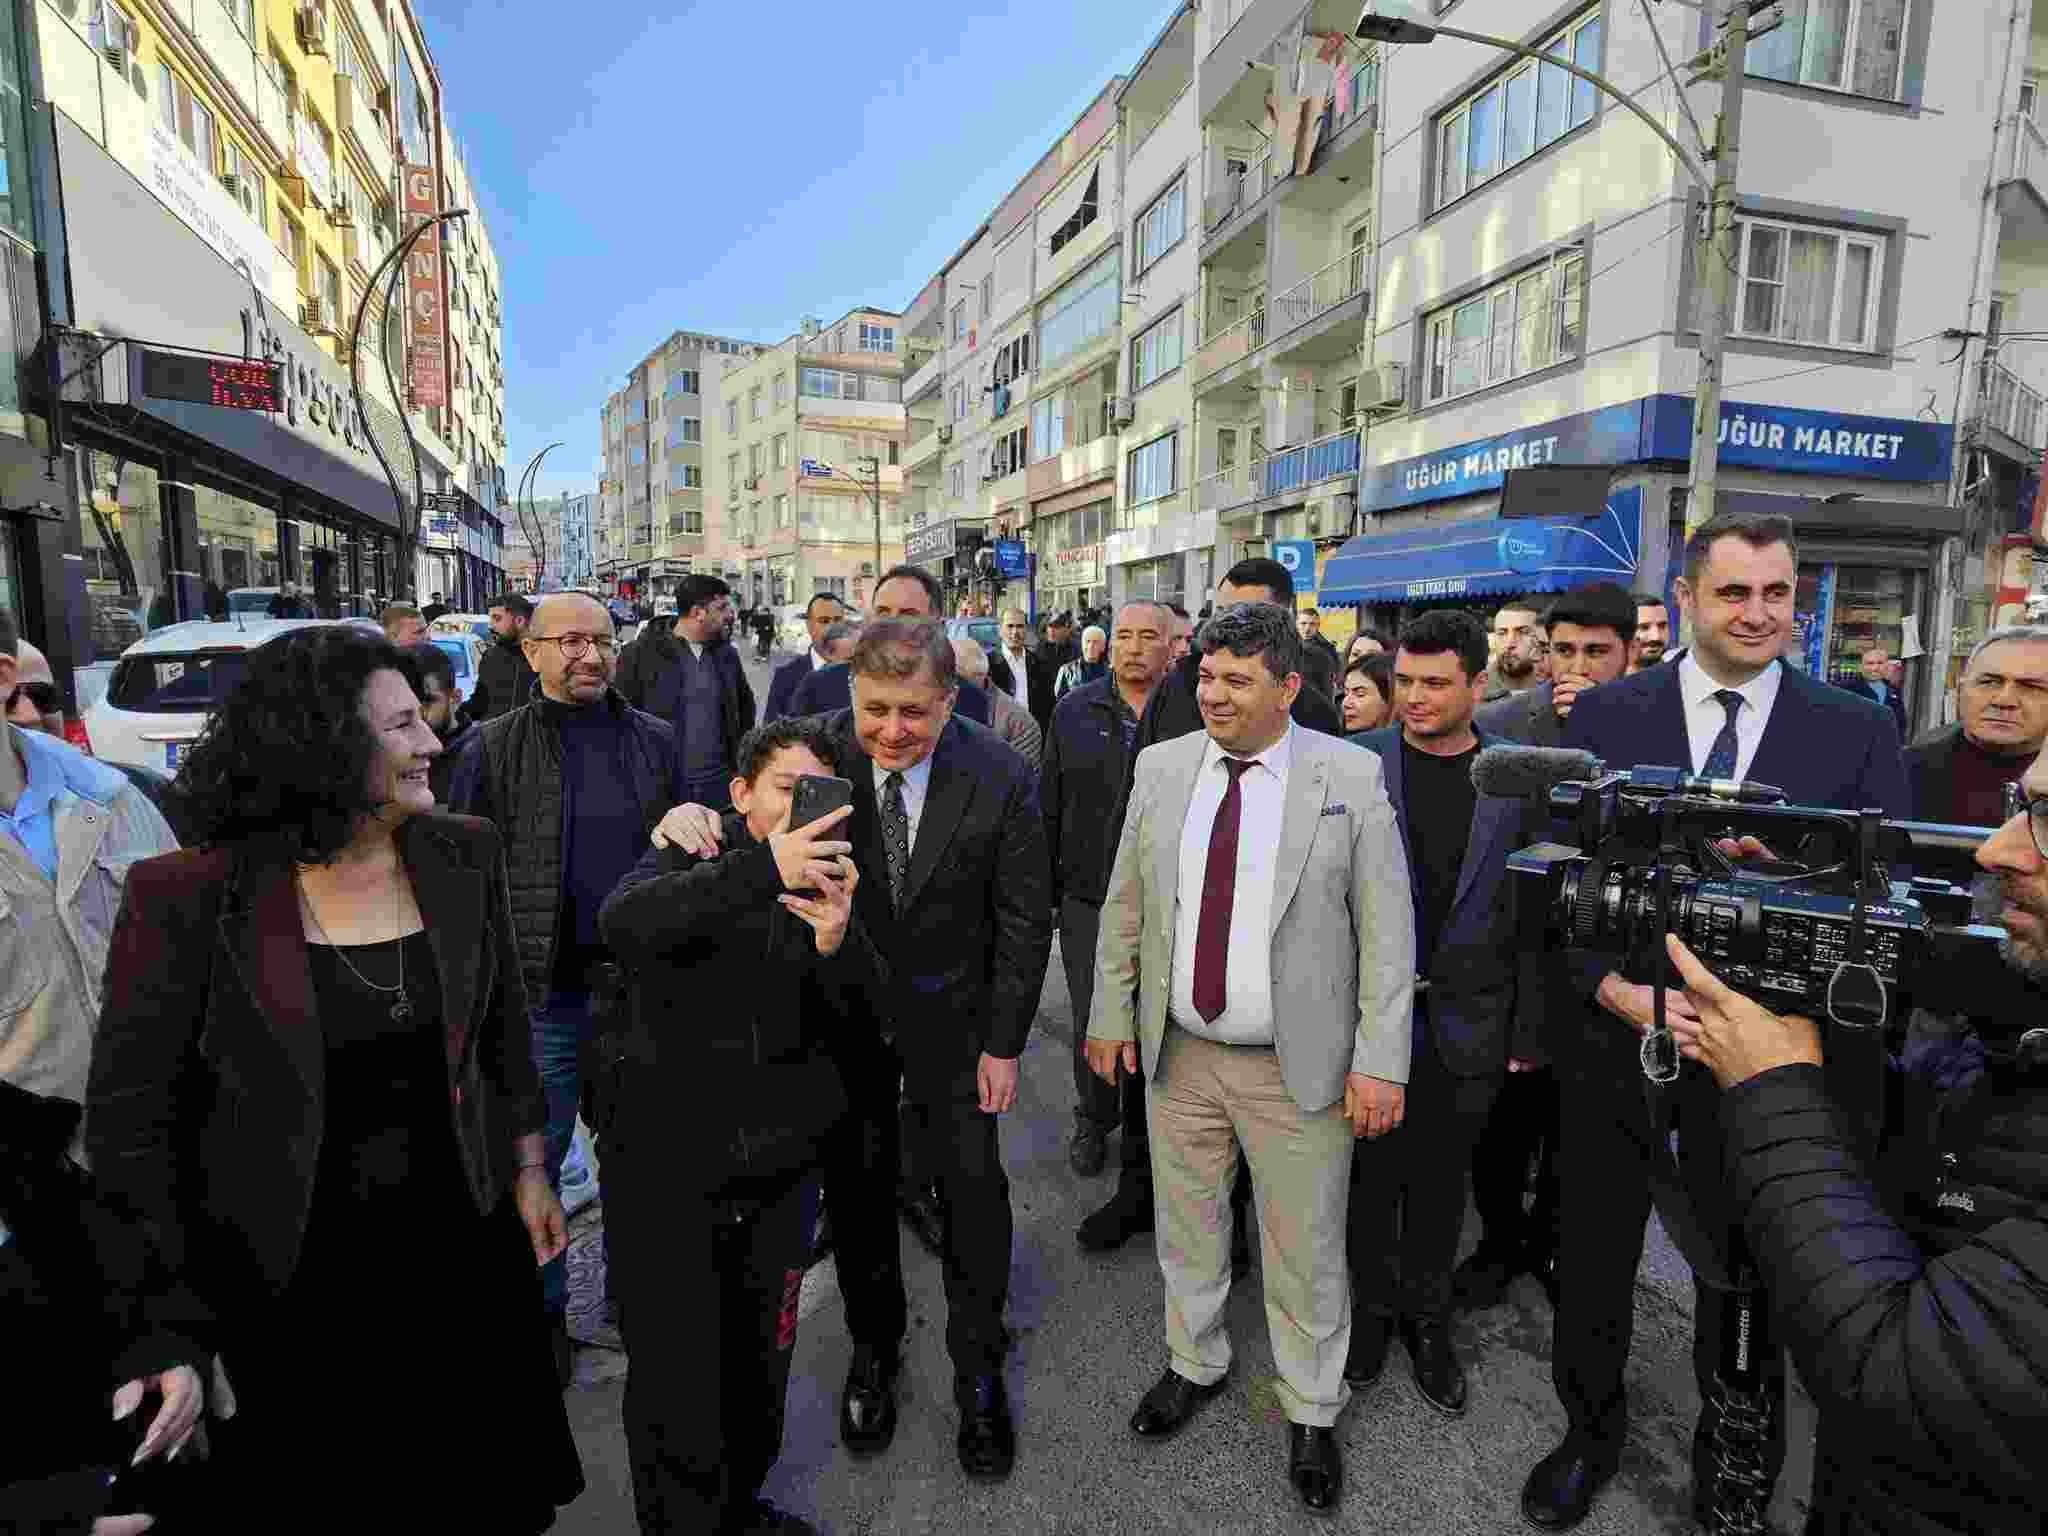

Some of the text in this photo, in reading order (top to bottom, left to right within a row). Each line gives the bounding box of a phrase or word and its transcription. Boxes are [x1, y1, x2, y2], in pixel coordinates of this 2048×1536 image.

[1717, 415, 1904, 460] UĞUR MARKET
[1406, 436, 1559, 490] UĞUR MARKET
